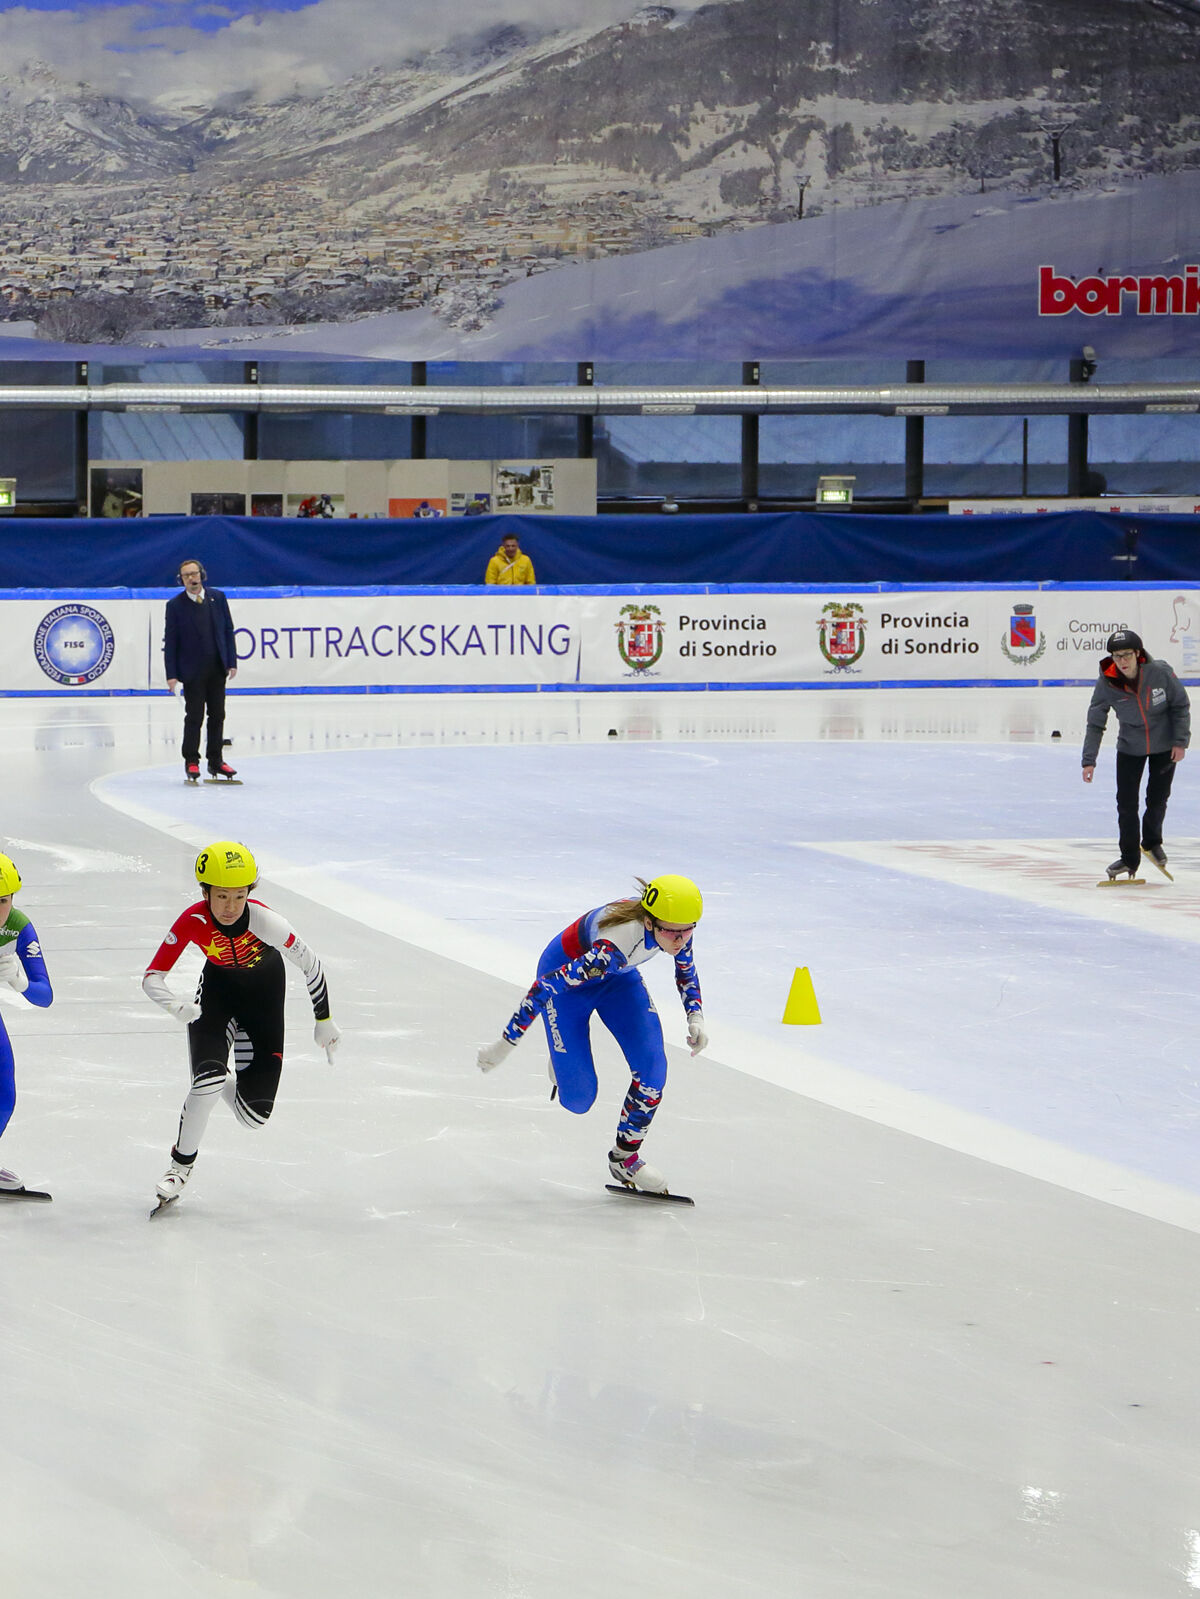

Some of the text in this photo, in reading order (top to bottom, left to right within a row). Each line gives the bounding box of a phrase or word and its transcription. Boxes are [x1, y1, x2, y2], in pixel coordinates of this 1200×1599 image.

[1038, 264, 1200, 316] bormi
[678, 615, 767, 631] Provincia
[880, 613, 969, 629] Provincia
[1068, 619, 1129, 633] Comune
[35, 605, 114, 681] FEDERAZIONE ITALIANA SPORT DEL GHIACCIO
[63, 641, 85, 649] FISG
[233, 624, 571, 660] ORTTRACKSKATING
[679, 640, 777, 657] di Sondrio
[881, 638, 979, 655] di Sondrio
[1056, 638, 1107, 651] di Valdi
[196, 853, 209, 874] 3
